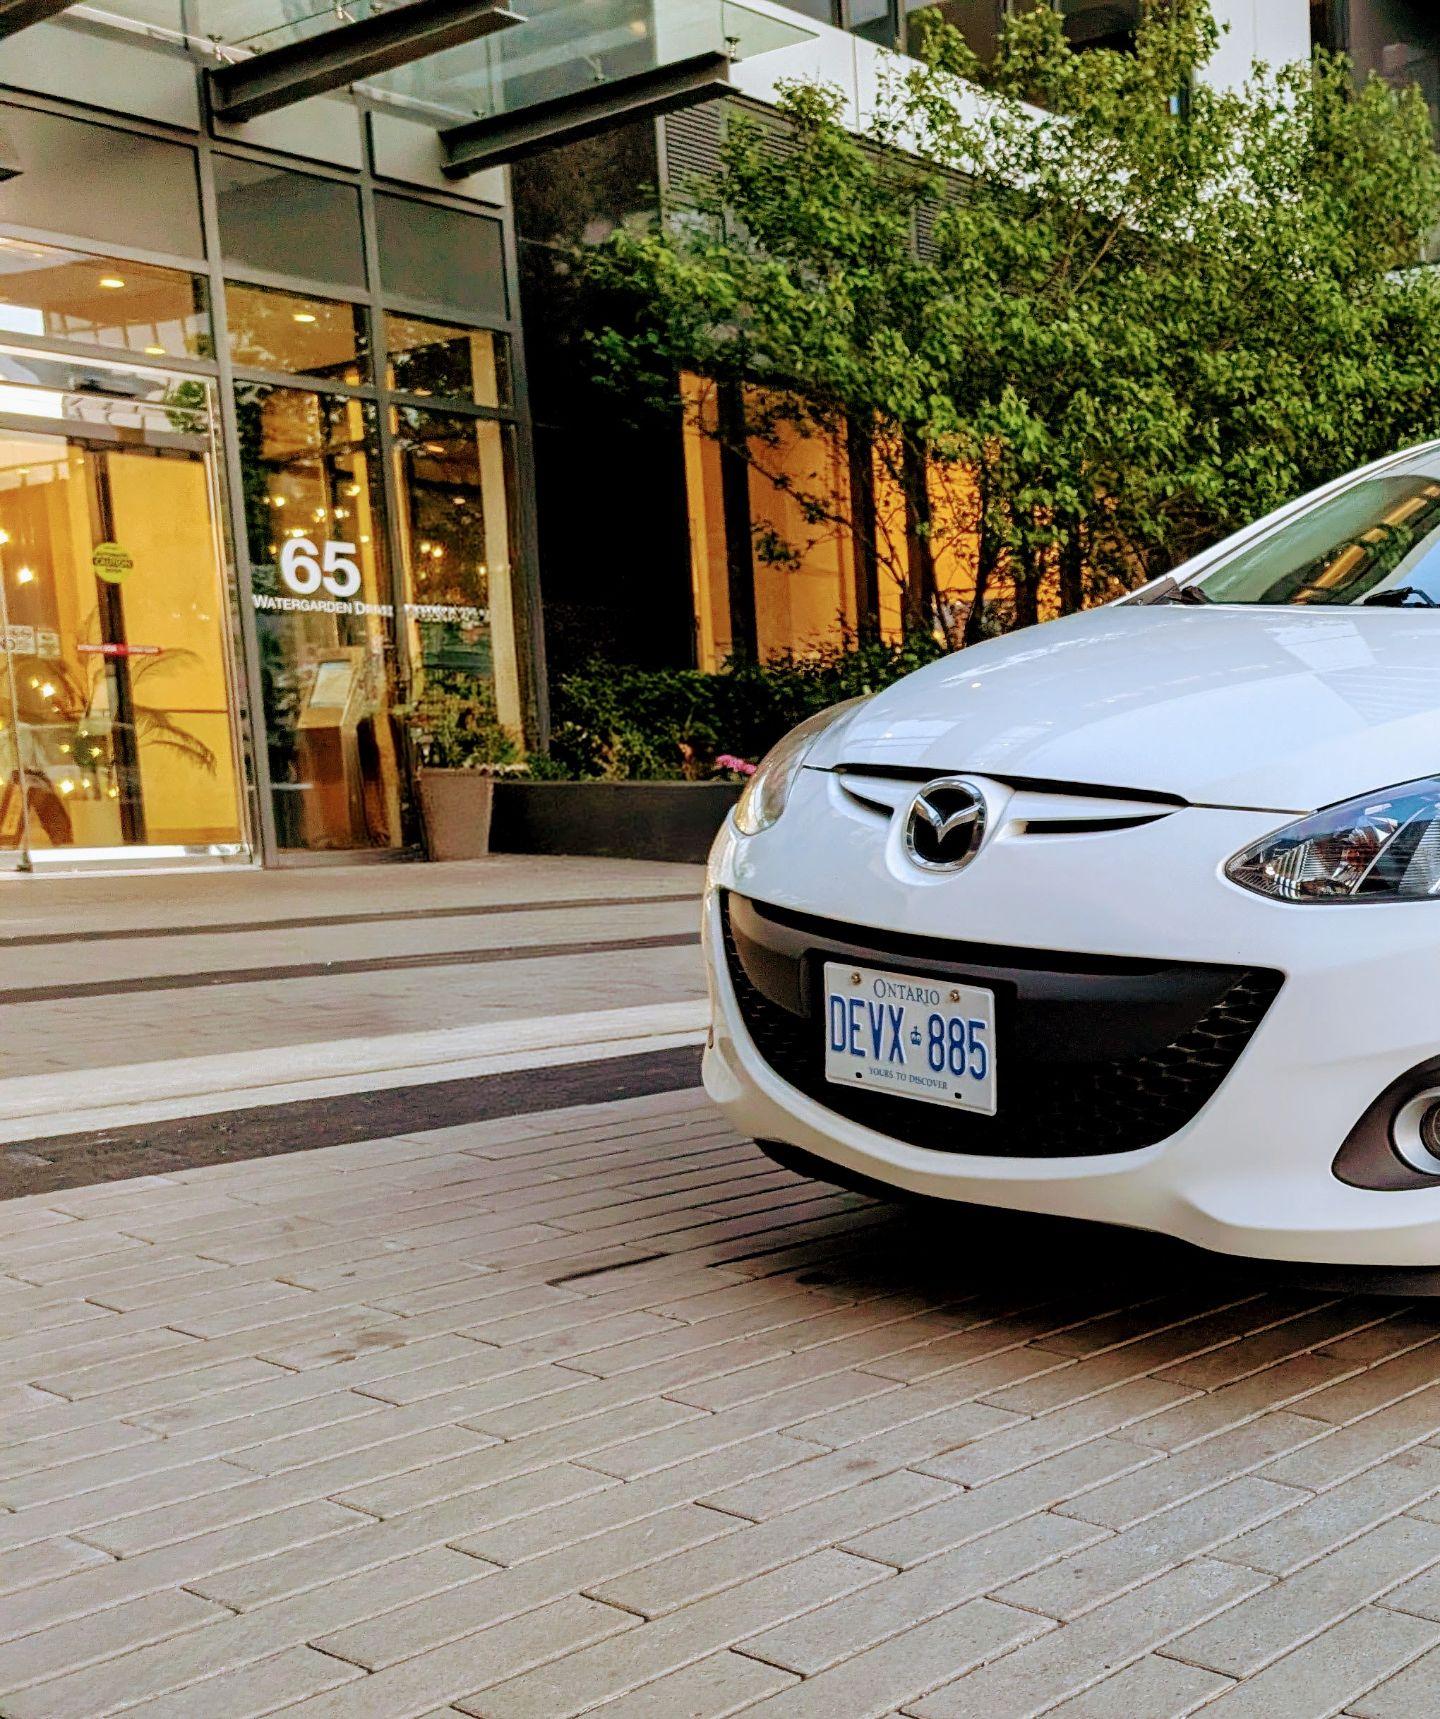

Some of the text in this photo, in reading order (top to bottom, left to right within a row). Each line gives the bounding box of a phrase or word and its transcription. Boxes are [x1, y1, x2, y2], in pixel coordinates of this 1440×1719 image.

[281, 538, 362, 597] 65
[873, 979, 940, 1006] ONTARIO
[829, 995, 988, 1081] DEVX 885
[869, 1067, 894, 1079] YOURS
[896, 1072, 906, 1081] TO
